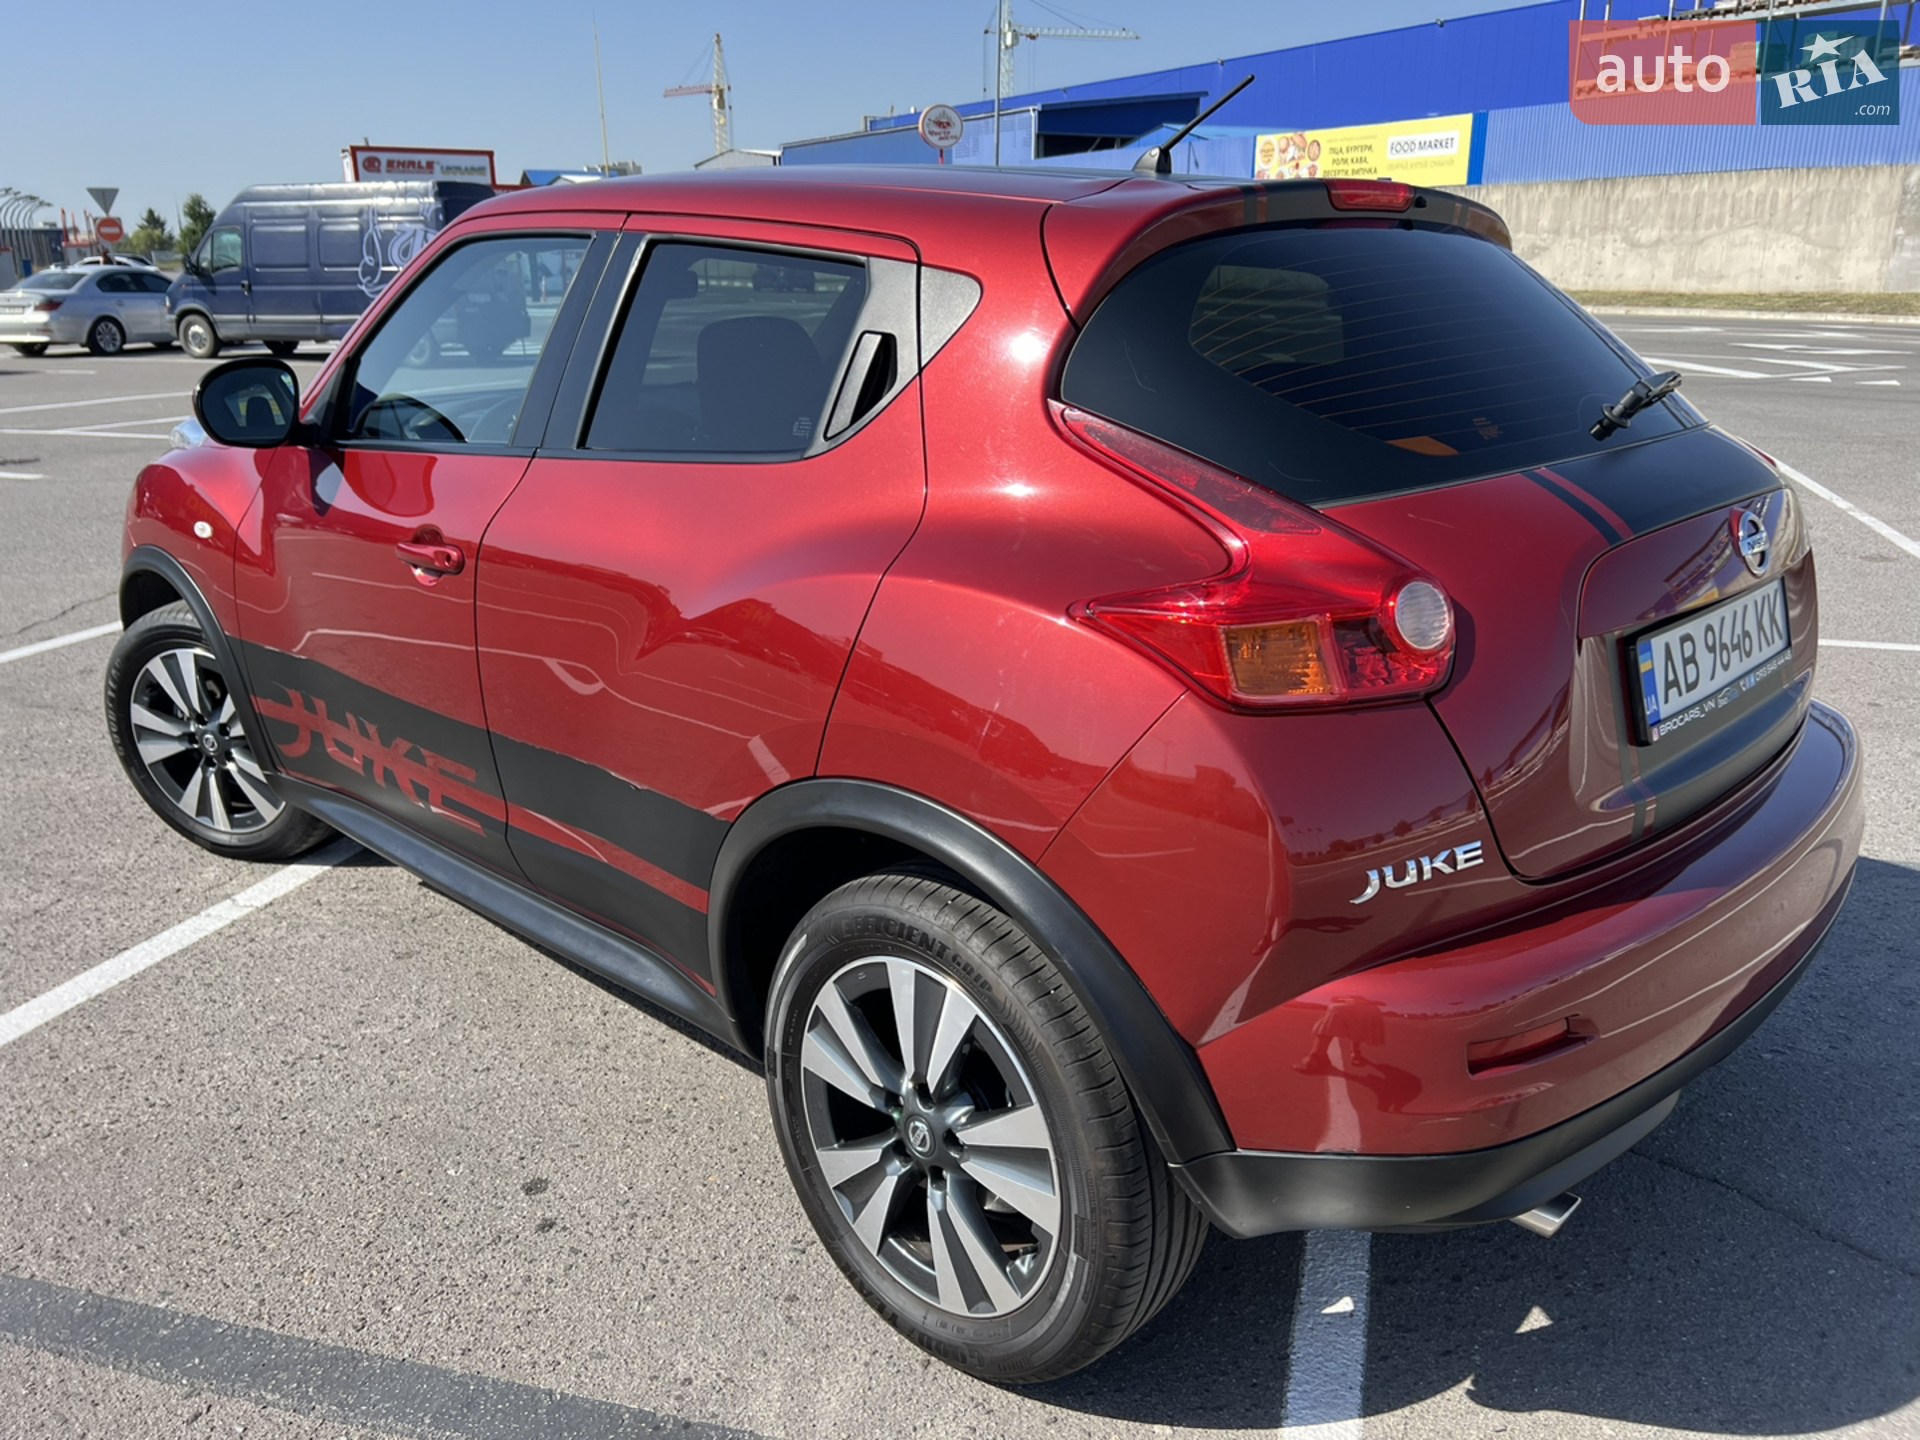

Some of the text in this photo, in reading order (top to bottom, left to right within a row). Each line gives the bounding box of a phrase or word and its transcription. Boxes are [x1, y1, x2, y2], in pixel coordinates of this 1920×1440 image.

[386, 159, 435, 170] EHRLE
[1390, 137, 1455, 155] FOOD MARKET
[1663, 588, 1784, 705] AB 9646 KK
[277, 688, 488, 838] JUKE
[1349, 840, 1485, 905] JUKE
